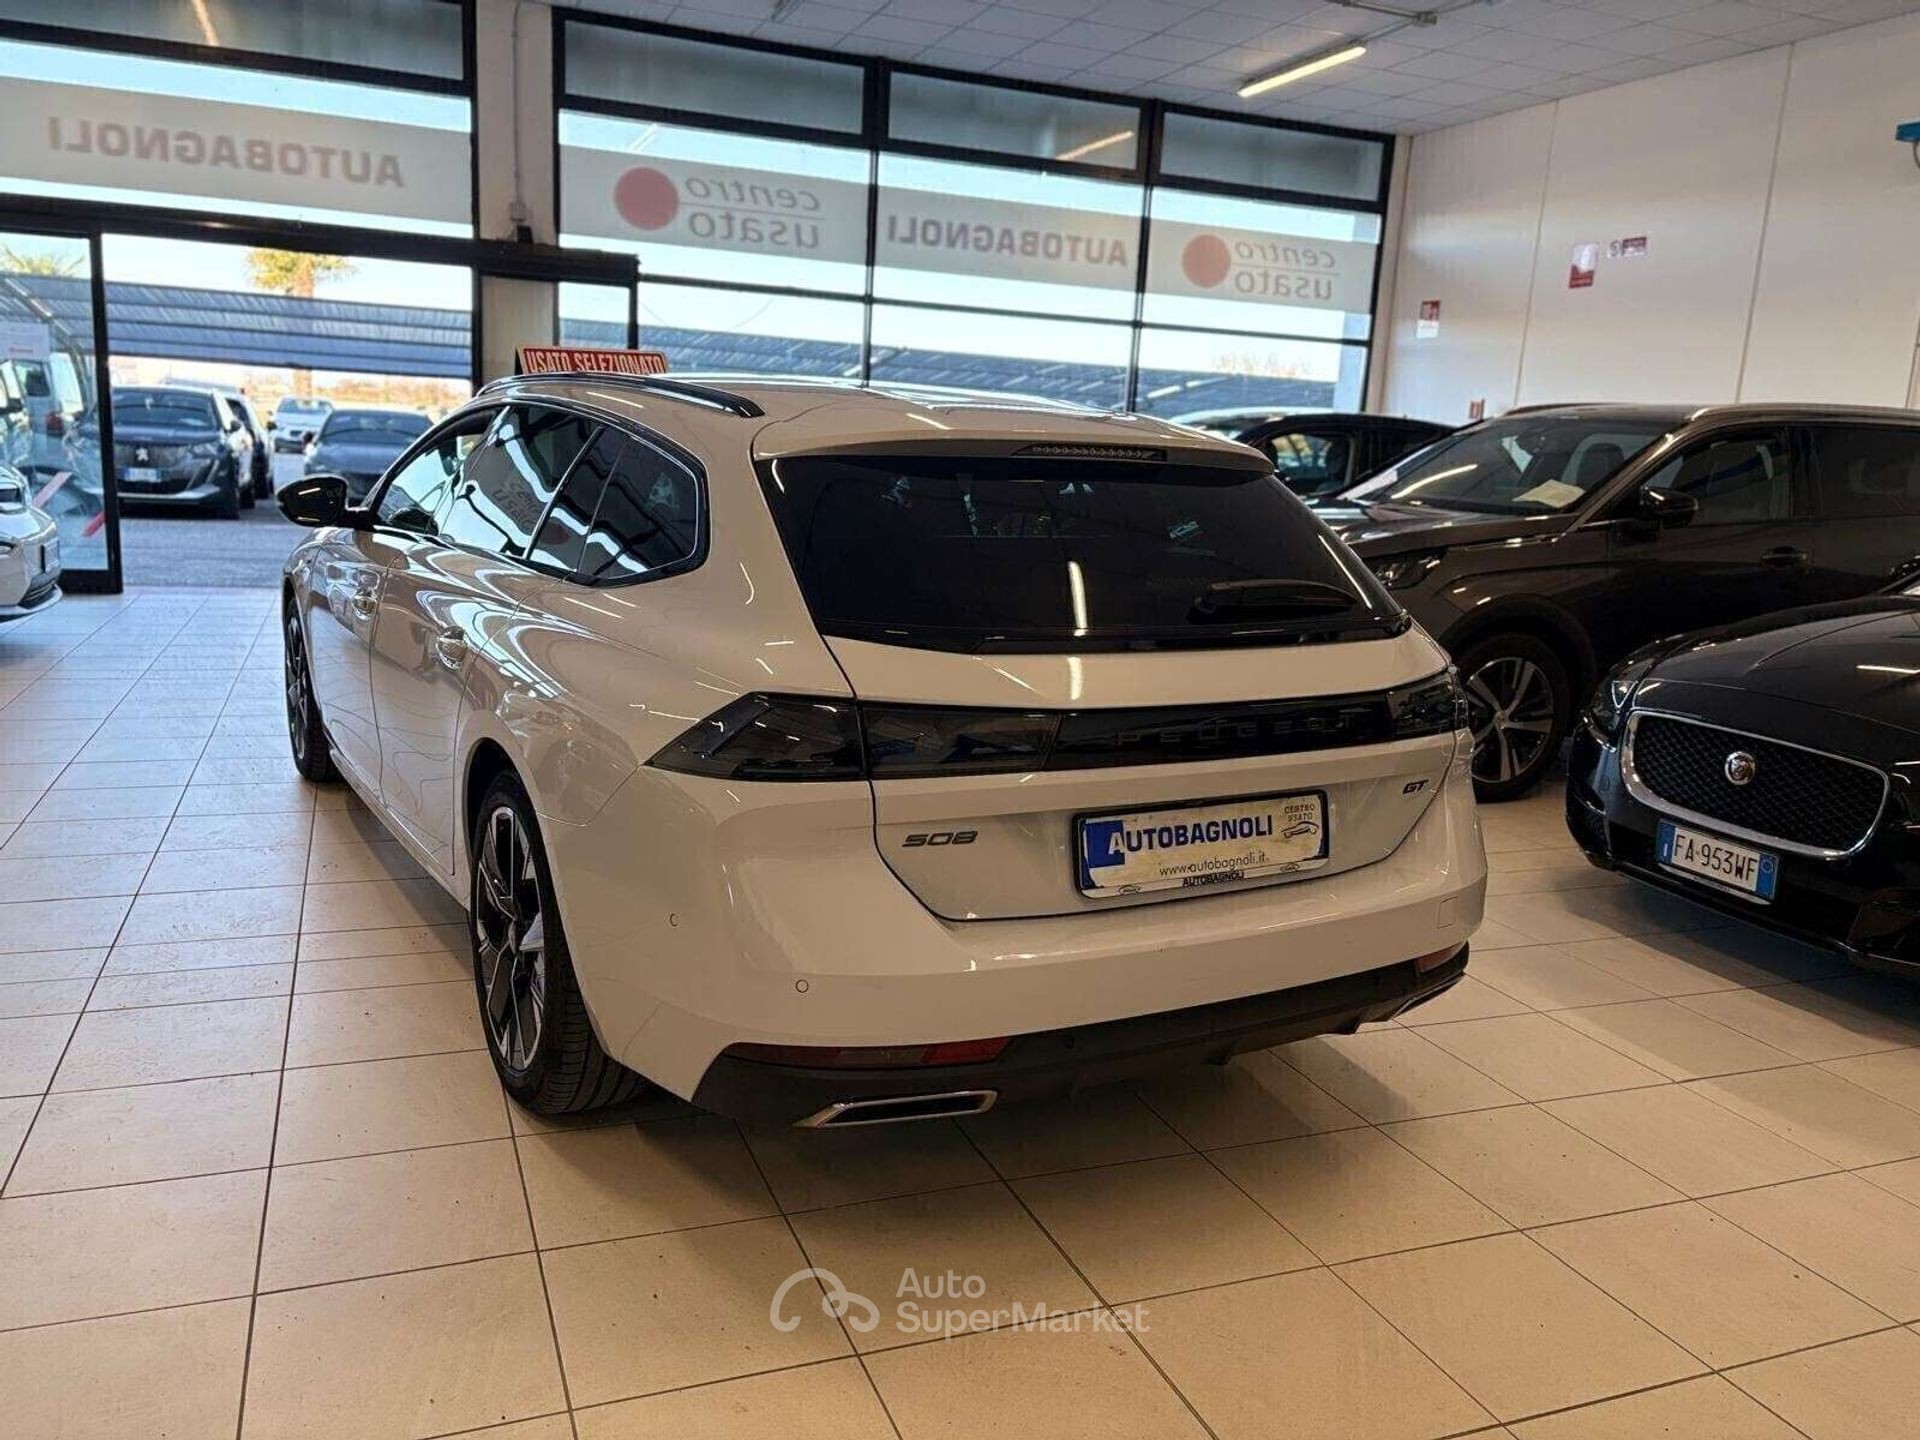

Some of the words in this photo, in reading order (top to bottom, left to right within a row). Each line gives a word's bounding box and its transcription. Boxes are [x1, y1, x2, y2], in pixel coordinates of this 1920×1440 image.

[526, 350, 572, 373] USATO
[573, 351, 665, 374] SELEZIONATO
[1402, 779, 1429, 795] GT
[901, 830, 979, 847] 508
[1108, 814, 1274, 856] AUTOBAGNOLI
[1159, 849, 1267, 877] www.autobagnoli.it
[1182, 869, 1245, 888] AUTOBAGNOLI
